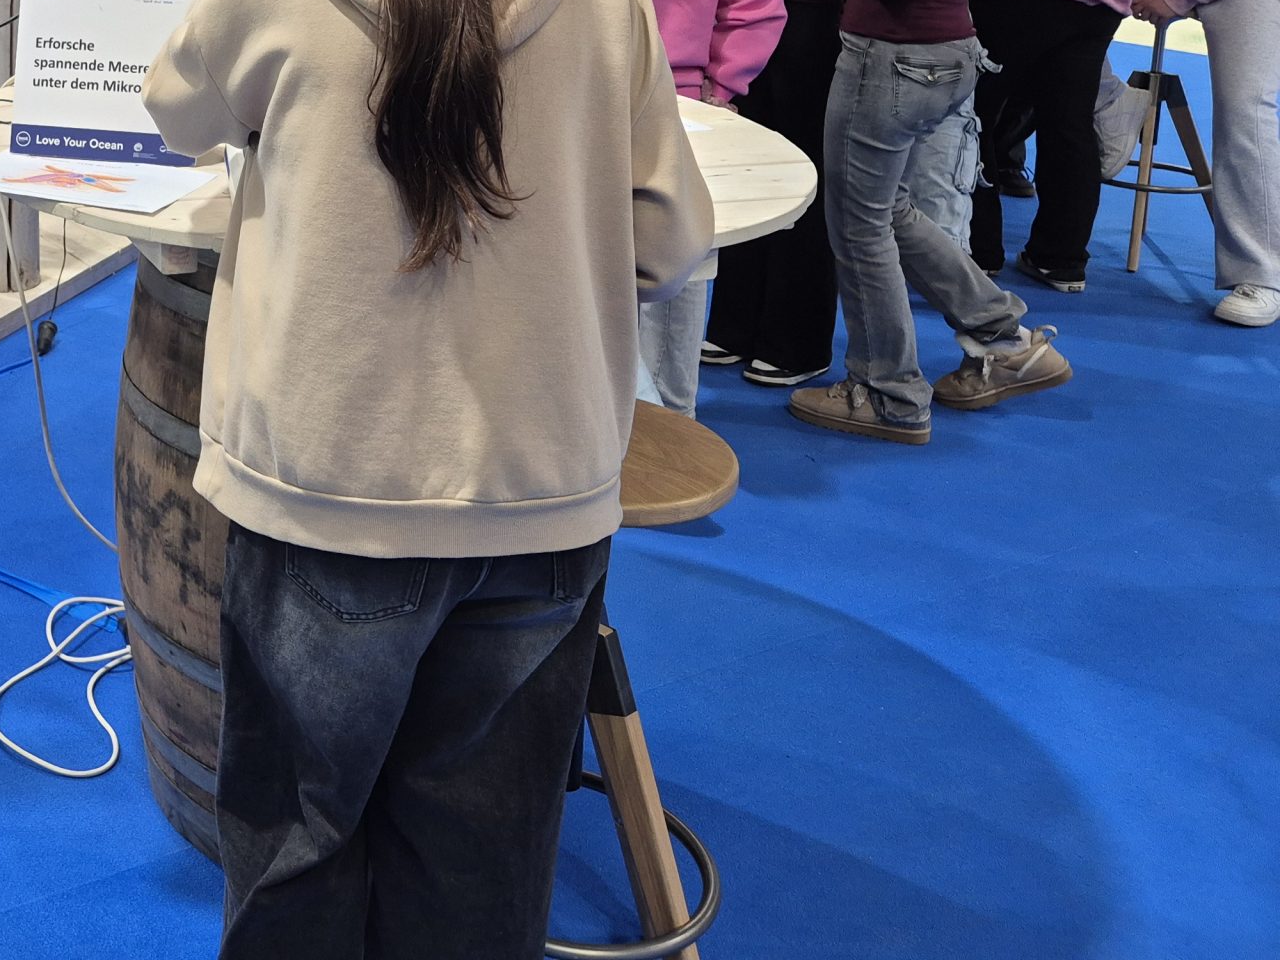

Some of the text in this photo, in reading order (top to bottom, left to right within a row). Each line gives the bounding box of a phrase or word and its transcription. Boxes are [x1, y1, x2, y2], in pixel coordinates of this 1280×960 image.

[35, 37, 95, 52] Erforsche
[33, 57, 150, 74] spannende Meere
[33, 77, 142, 94] unter dem Mikro
[35, 134, 61, 146] Love
[63, 136, 87, 149] Your
[89, 138, 124, 151] Ocean
